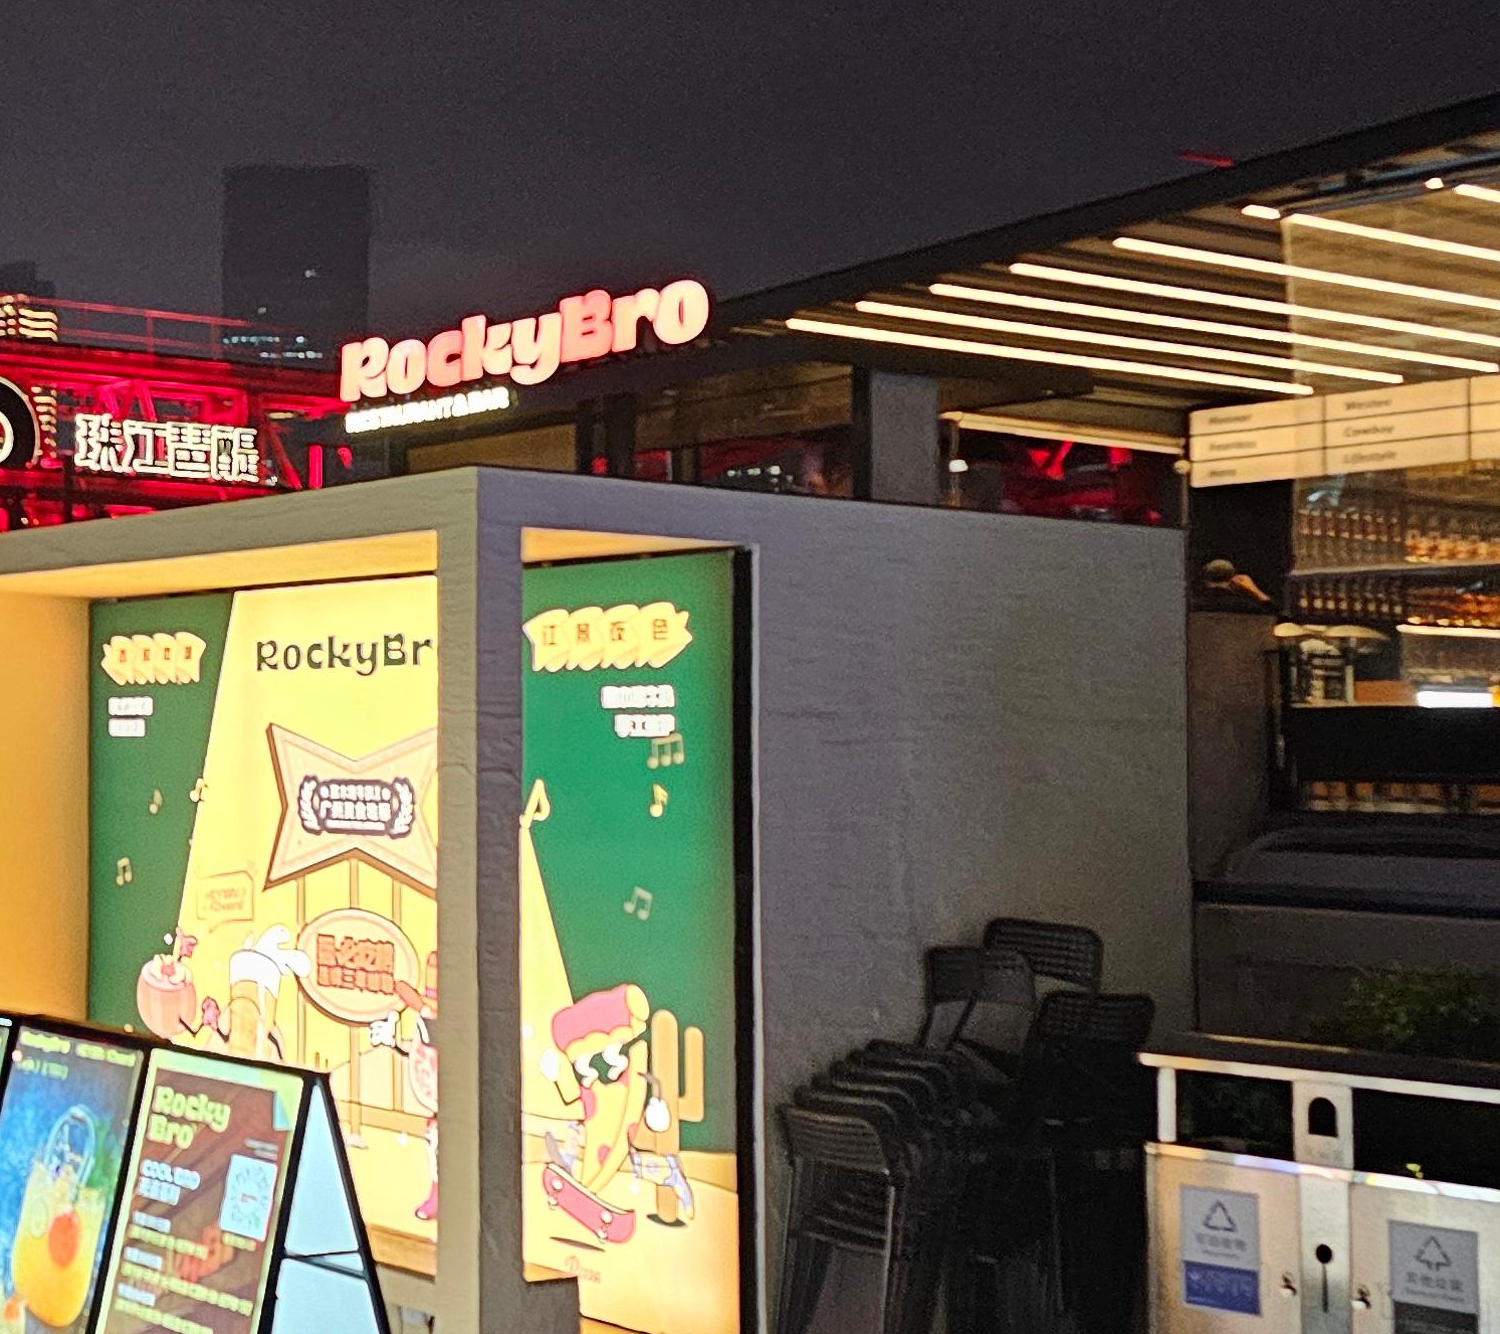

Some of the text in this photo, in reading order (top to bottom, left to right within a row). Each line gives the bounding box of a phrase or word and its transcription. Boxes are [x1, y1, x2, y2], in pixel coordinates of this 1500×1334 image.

[339, 279, 710, 403] RockyBro
[256, 633, 434, 677] RockyBr
[152, 1085, 232, 1133] Rocky
